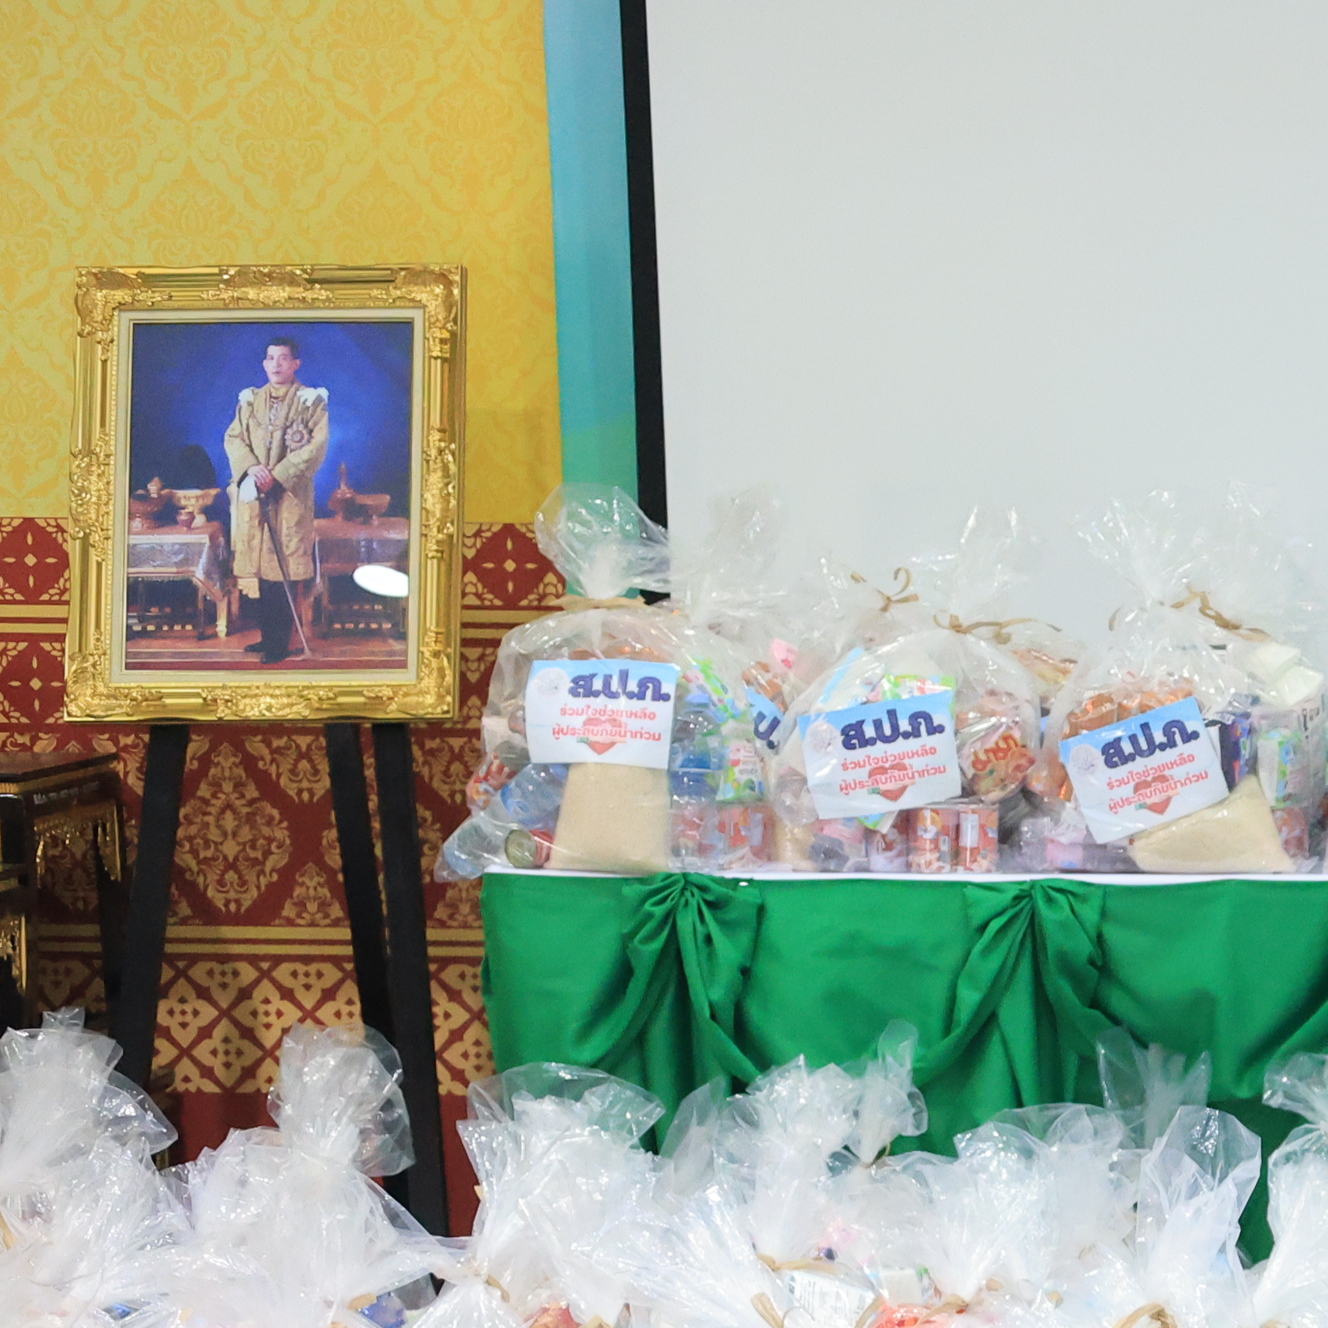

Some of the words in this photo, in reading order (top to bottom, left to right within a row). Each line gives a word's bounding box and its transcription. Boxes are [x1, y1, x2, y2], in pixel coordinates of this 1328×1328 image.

[569, 669, 671, 702] ส.ป.ก.
[841, 708, 946, 751] ส.ป.ก.
[1100, 719, 1200, 769] ส.ป.ก.
